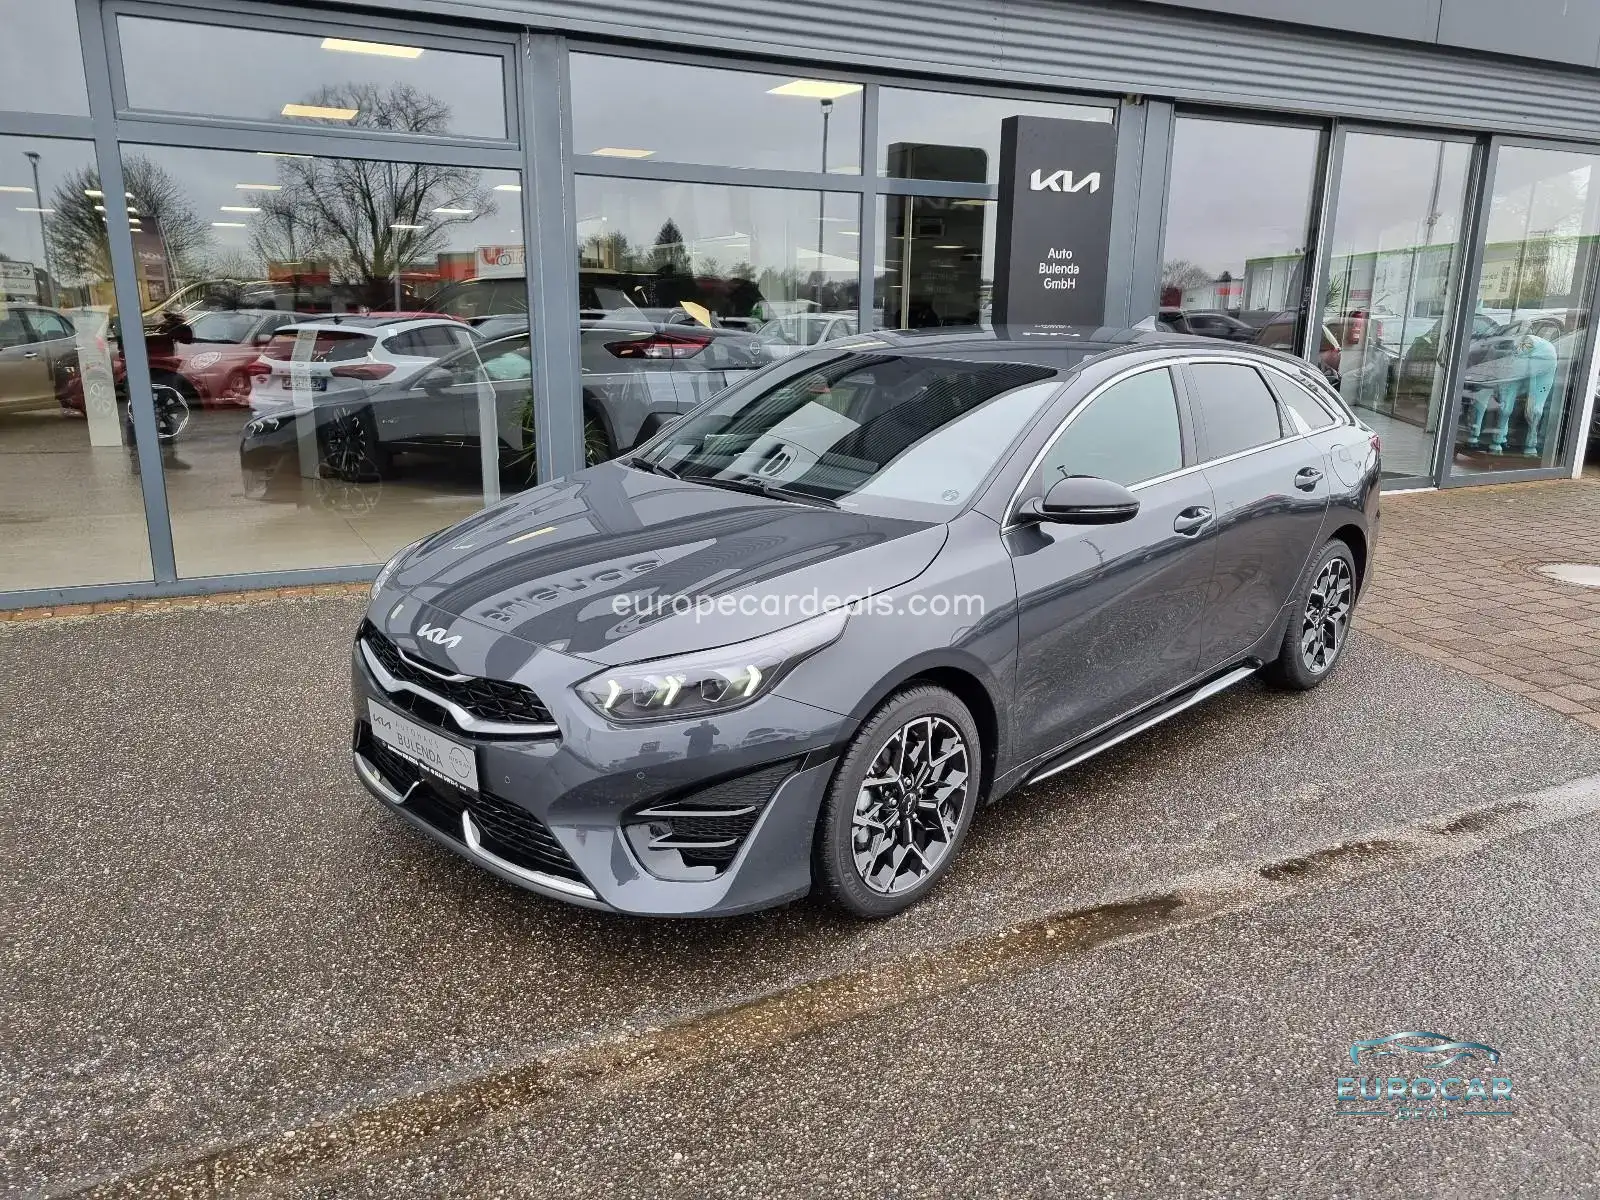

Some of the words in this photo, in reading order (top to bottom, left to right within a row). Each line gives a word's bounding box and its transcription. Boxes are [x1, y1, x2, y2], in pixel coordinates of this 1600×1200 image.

[1030, 168, 1101, 194] KIA
[1047, 247, 1073, 259] Auto
[1038, 262, 1080, 275] Bulenda
[1043, 277, 1076, 289] GmbH
[416, 622, 463, 649] KIA
[372, 712, 392, 730] KIA
[395, 720, 440, 749] AUTOHAUS
[397, 732, 444, 767] BULENDA
[448, 753, 472, 771] NISSAN
